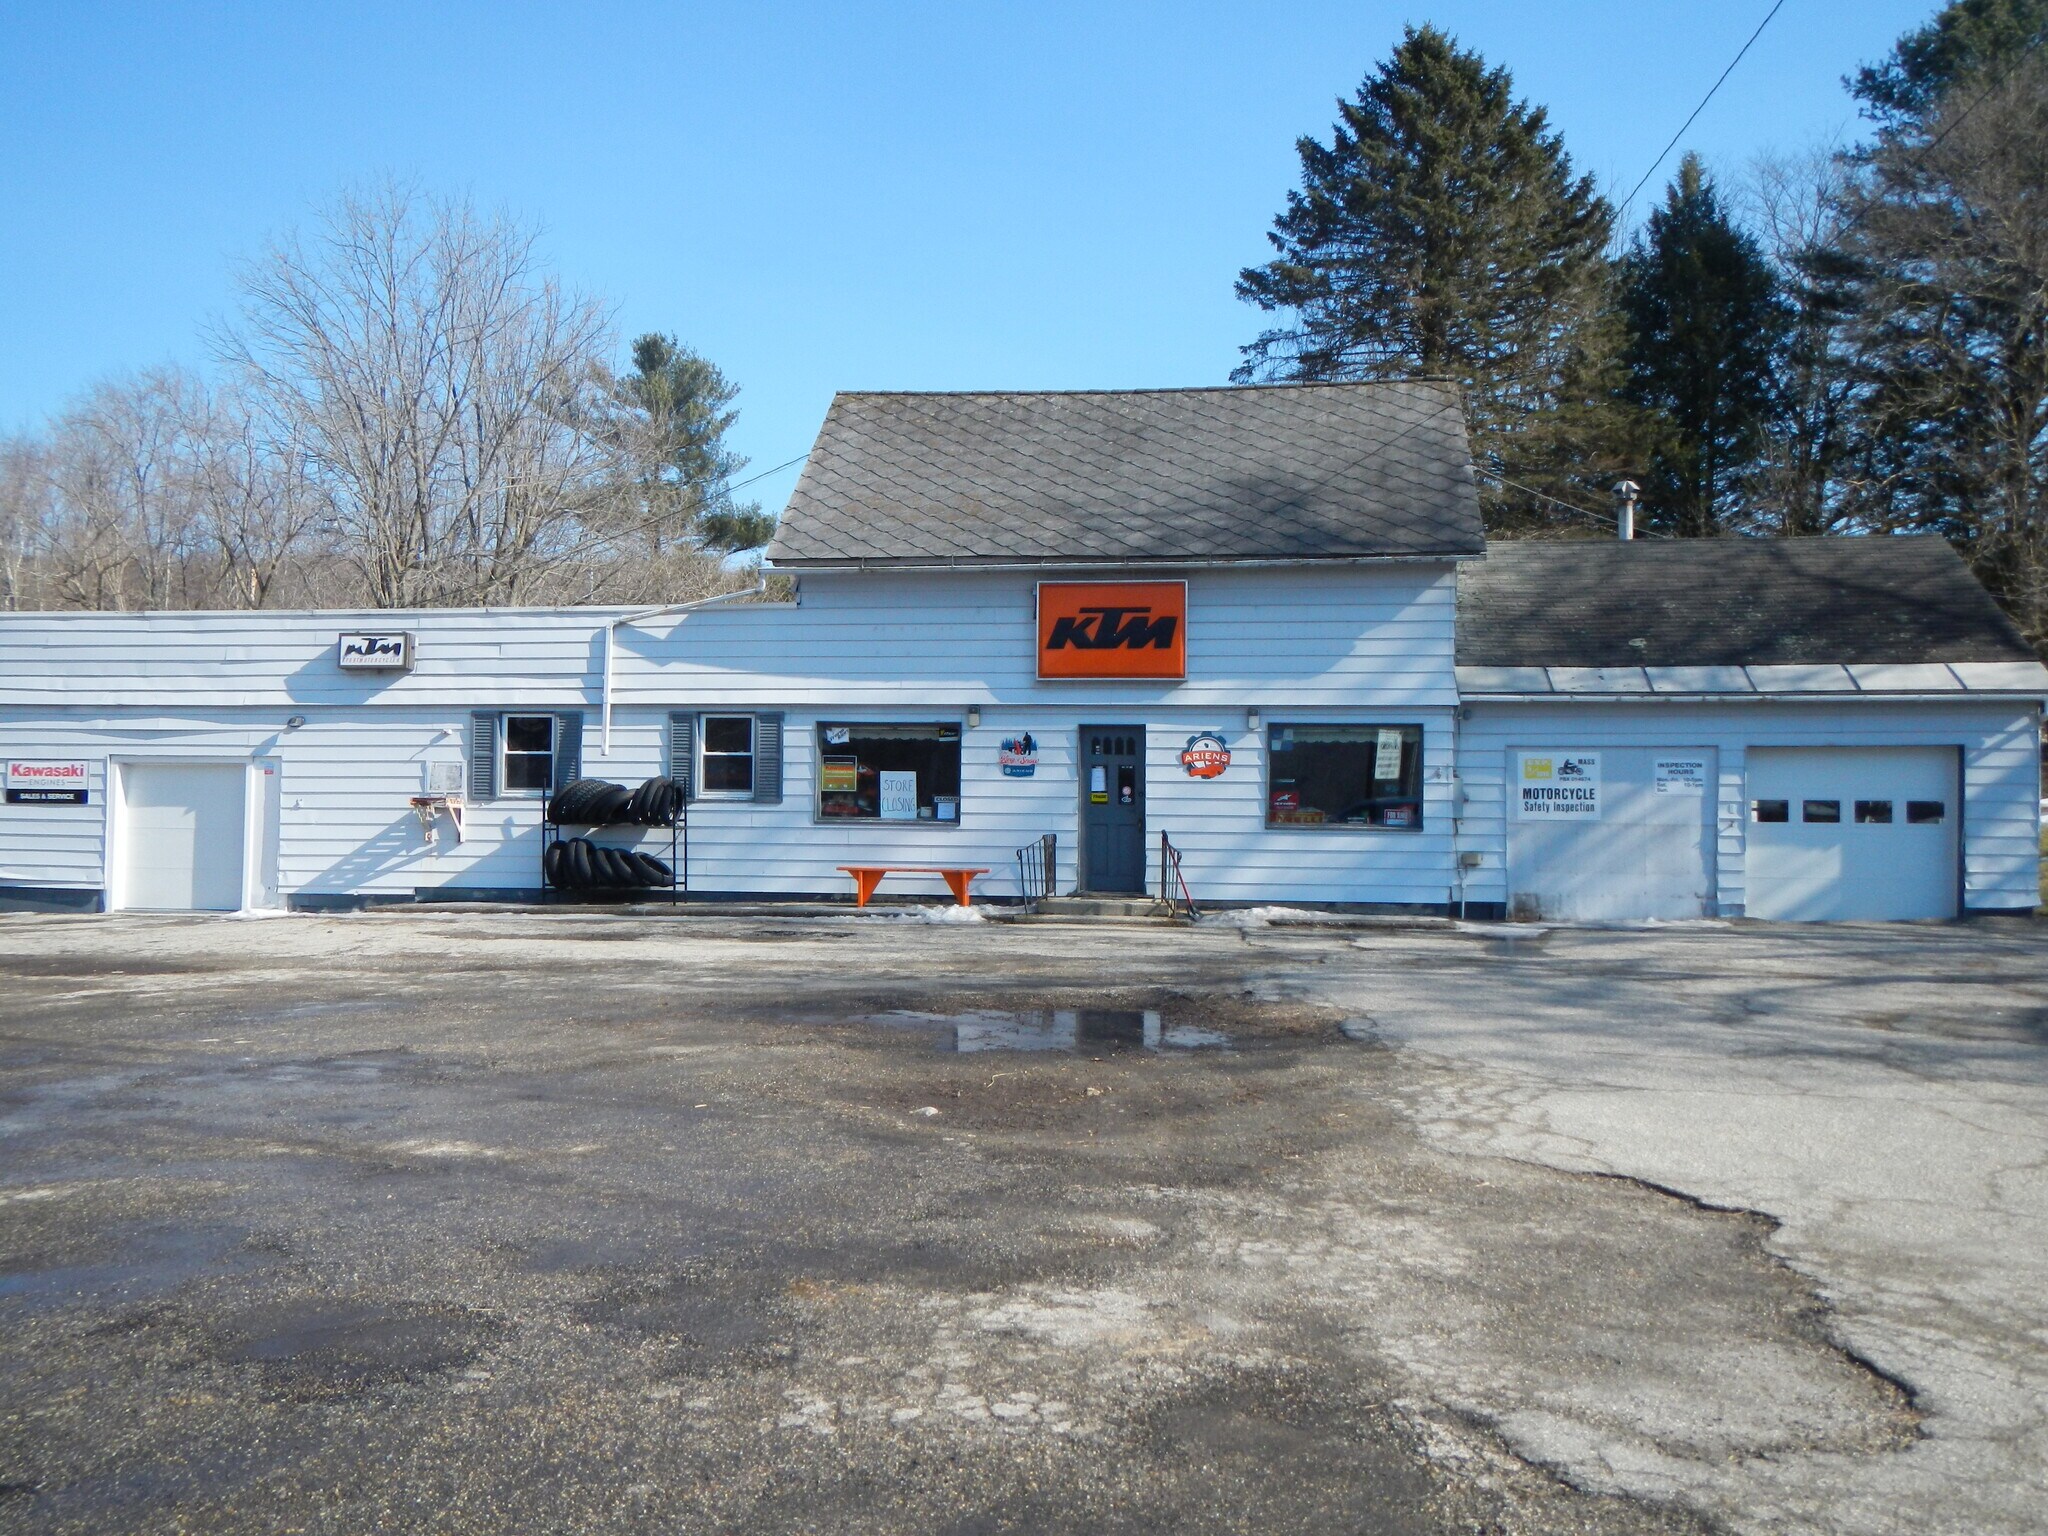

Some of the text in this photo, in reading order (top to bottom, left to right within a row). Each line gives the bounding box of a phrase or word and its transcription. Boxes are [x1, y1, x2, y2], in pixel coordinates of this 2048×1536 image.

[1046, 606, 1178, 649] KTM
[344, 637, 402, 656] KTM
[1185, 752, 1228, 762] ARIENS
[11, 763, 84, 777] Kawasaki
[1522, 787, 1596, 800] MOTORCYCLE
[881, 796, 916, 813] CLOSING
[1523, 801, 1596, 813] Safety Inspection
